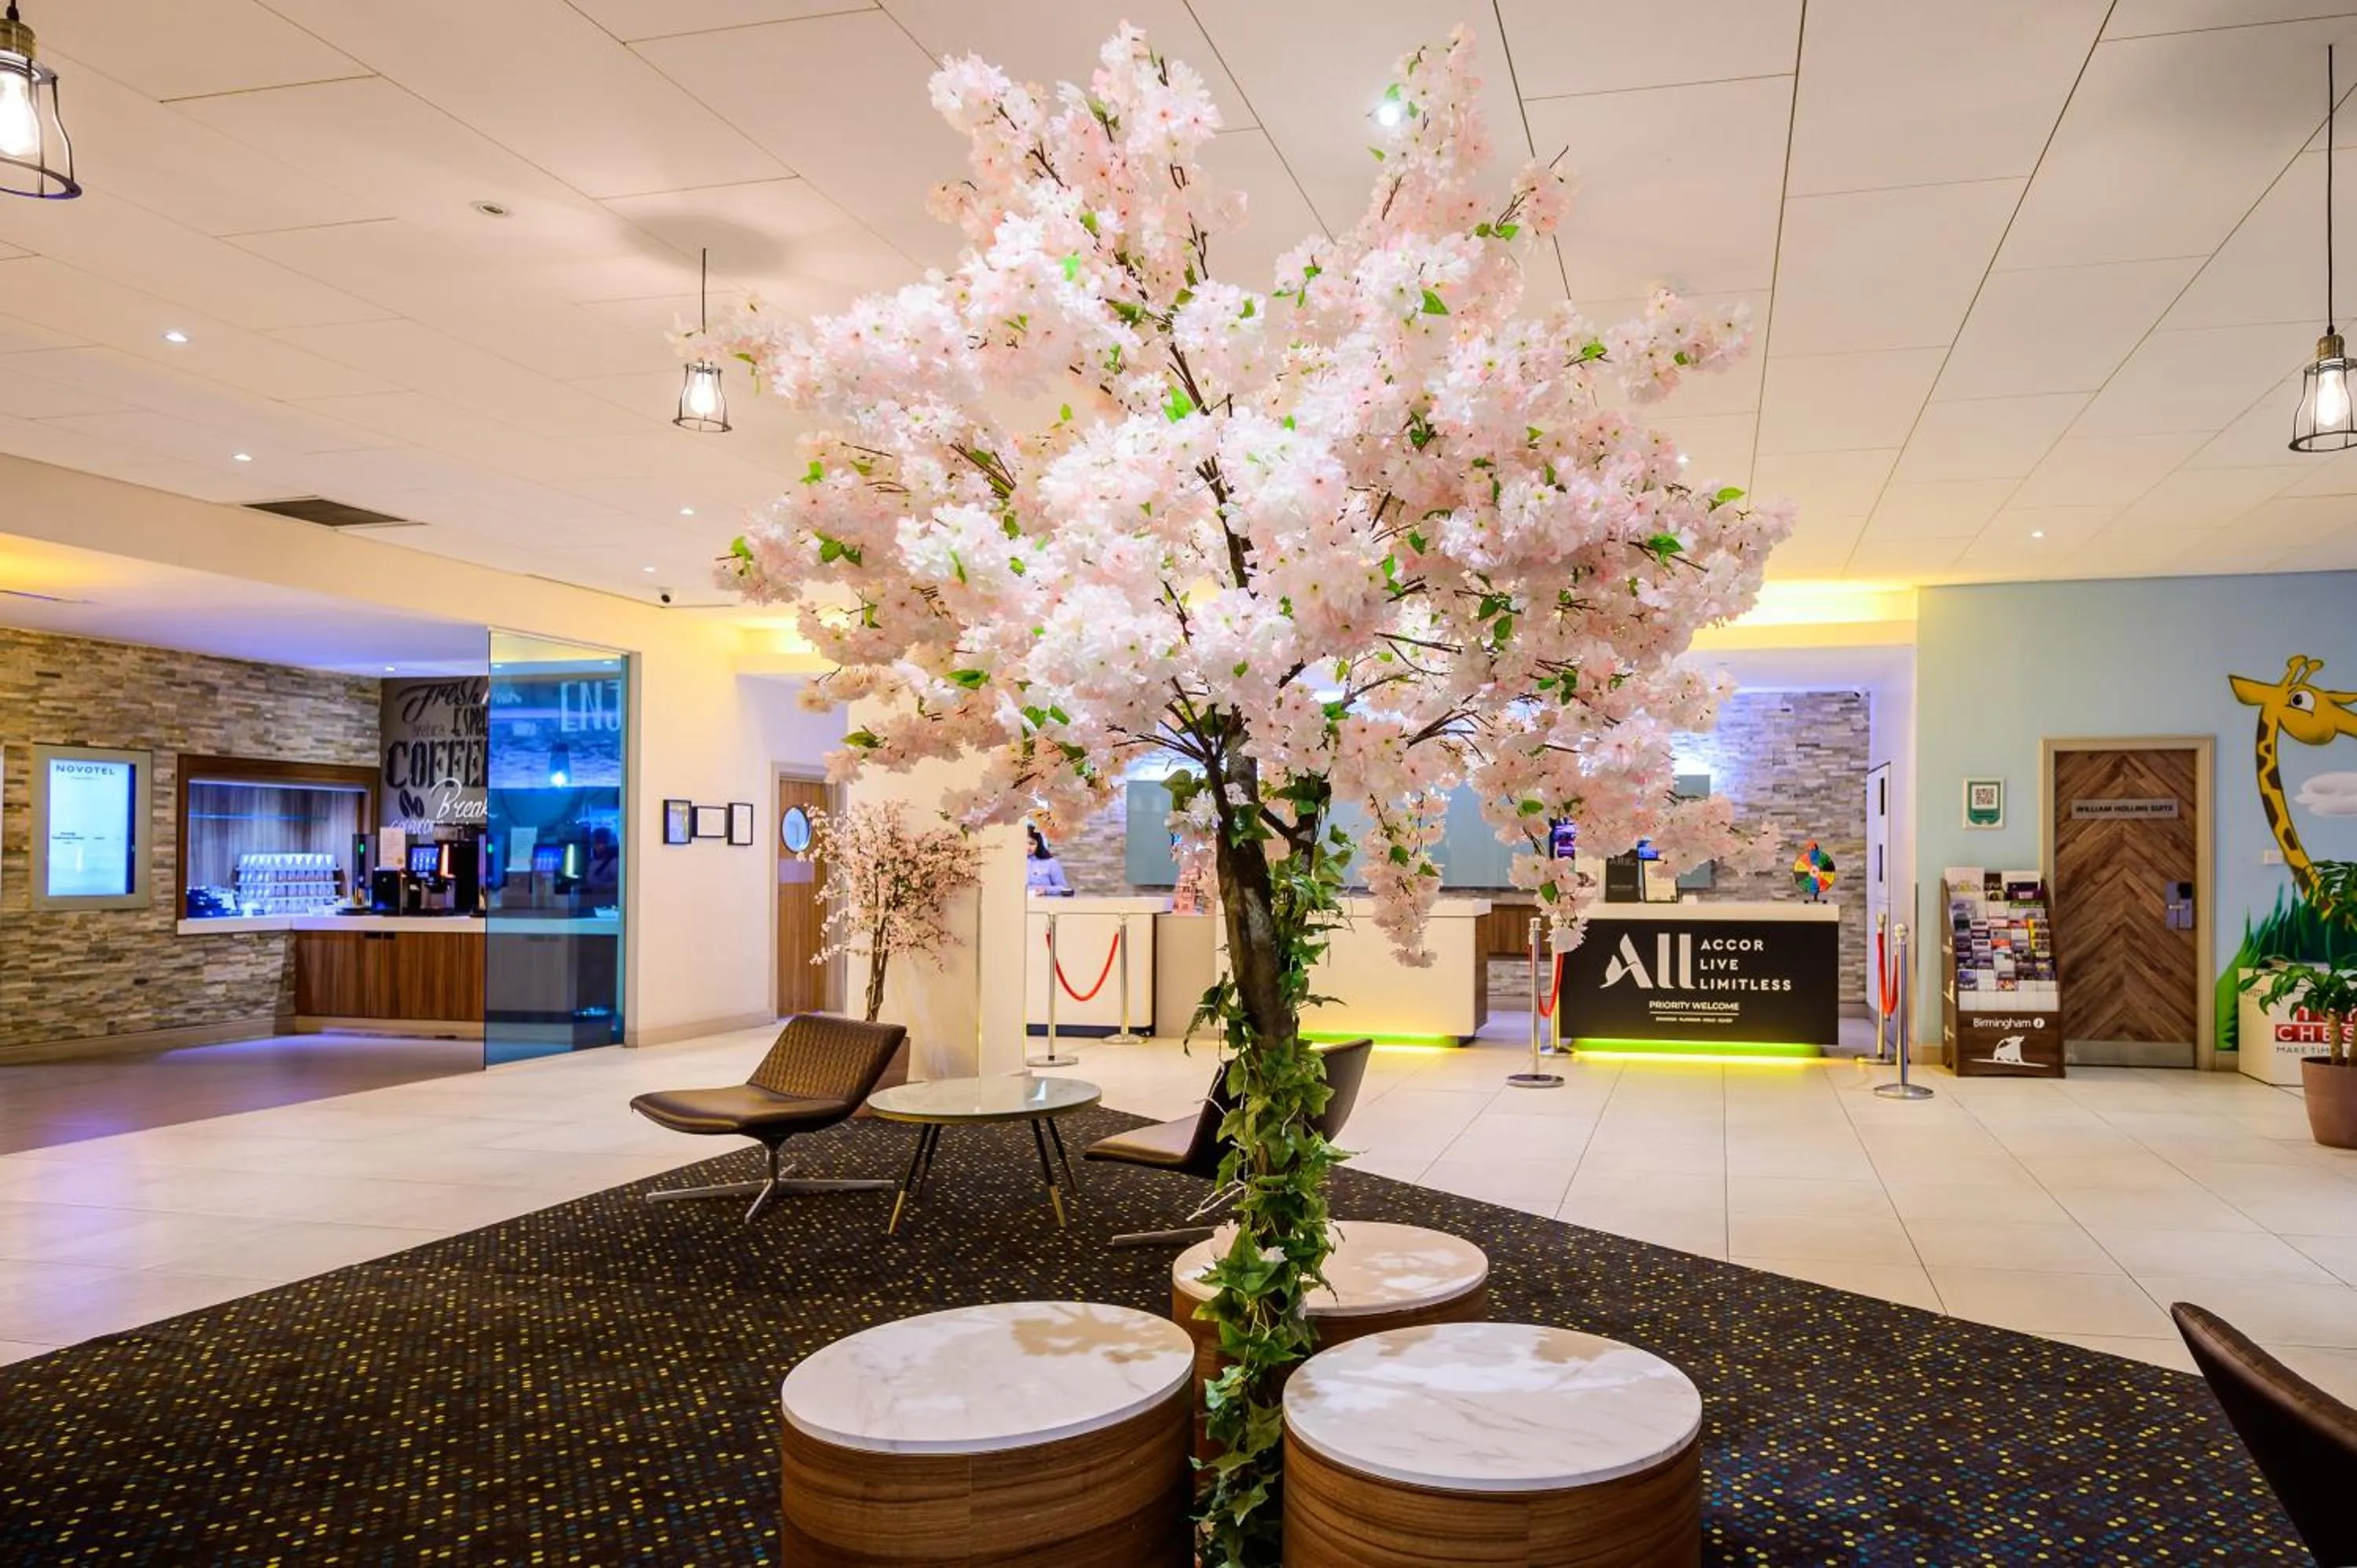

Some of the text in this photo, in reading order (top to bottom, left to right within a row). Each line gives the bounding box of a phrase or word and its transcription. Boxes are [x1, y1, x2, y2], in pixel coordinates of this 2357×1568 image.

[56, 764, 115, 775] NOVOTEL
[1700, 939, 1765, 952] ACCOR
[1699, 958, 1739, 971] LIVE
[1699, 978, 1792, 991] LIMITLESS
[1649, 1001, 1740, 1011] PRIORITY WELCOME
[1973, 1017, 2032, 1030] Birmingham
